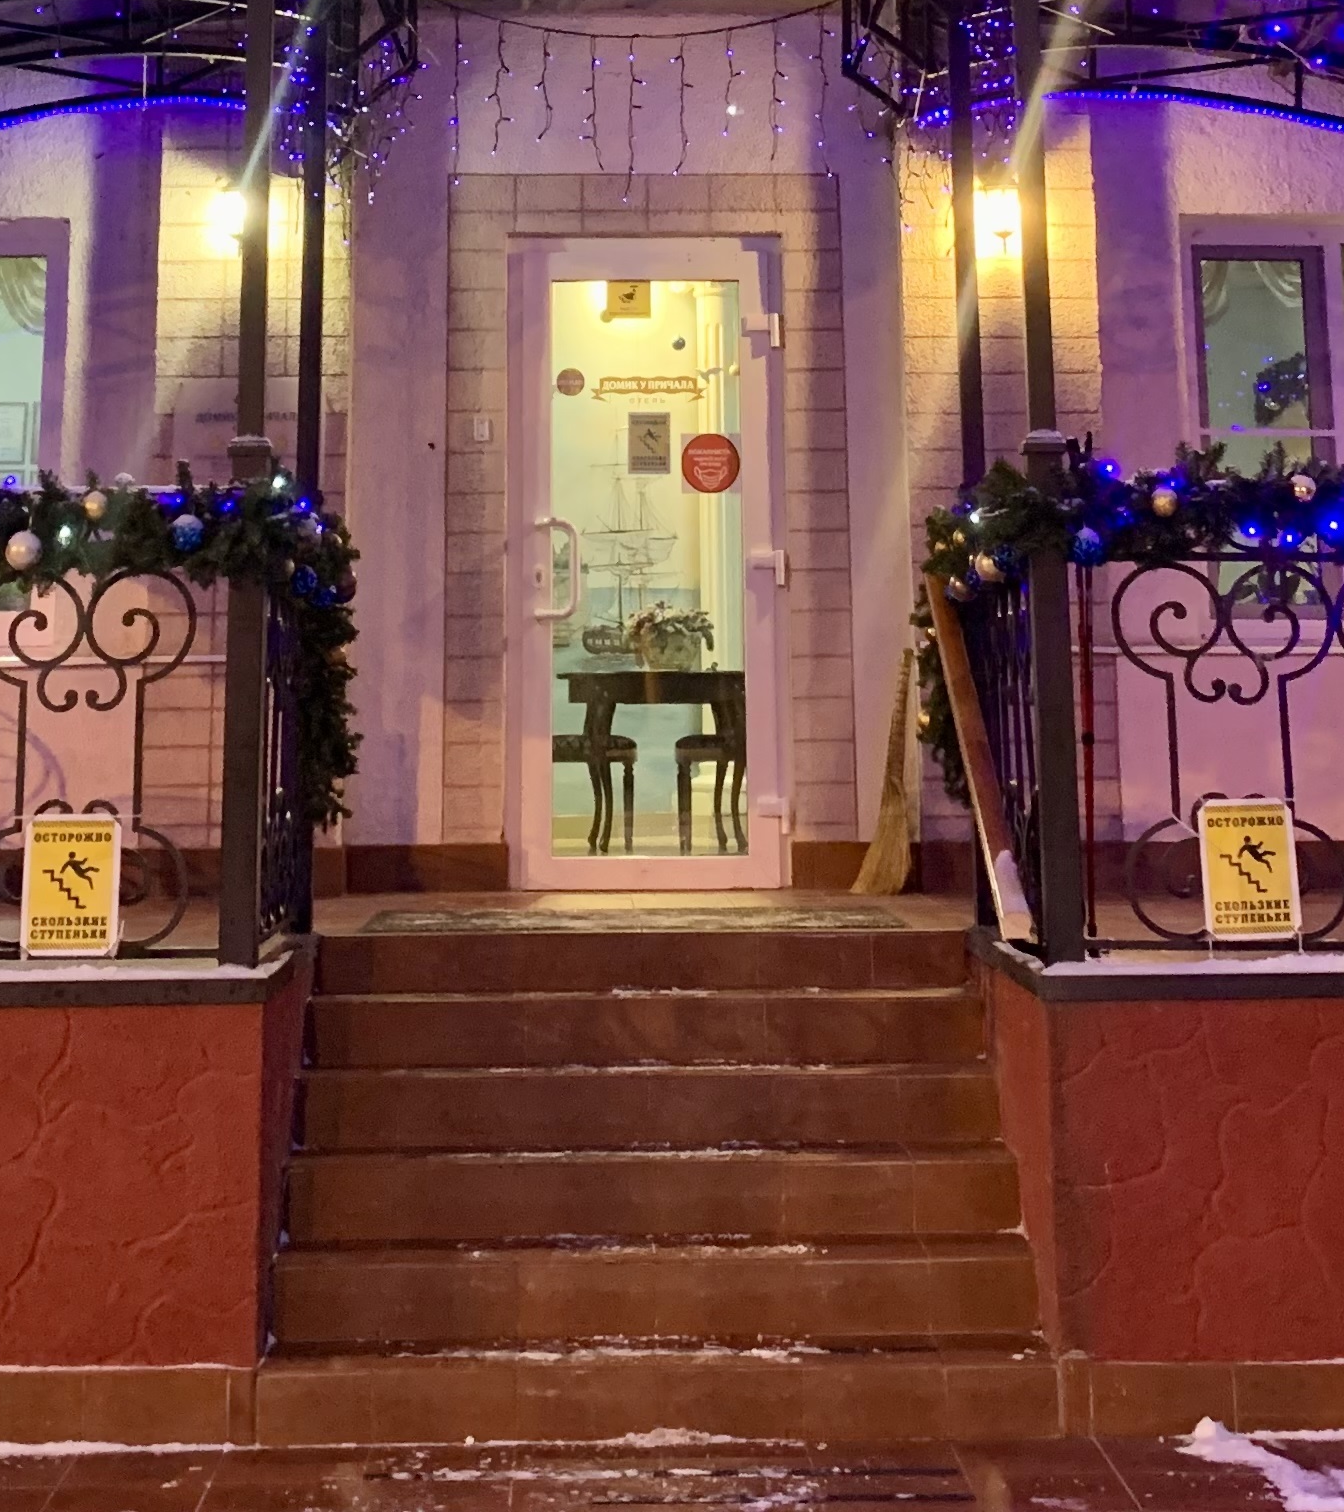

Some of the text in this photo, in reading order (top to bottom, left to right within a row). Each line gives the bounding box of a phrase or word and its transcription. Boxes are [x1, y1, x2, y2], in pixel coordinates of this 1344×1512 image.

[601, 380, 695, 390] ДОМИК У ПРИЧАЛА
[1207, 816, 1284, 828] ОСТОРОЖНО
[34, 832, 112, 843] ОСТОРОЖНО
[1214, 899, 1291, 911] СКОЛЬЗКИЕ
[31, 916, 107, 927] СКОЛЬЗКИЕ
[1215, 912, 1291, 924] СТУПЕНЬКИ
[30, 929, 107, 940] СТУПЕНЬКИ
